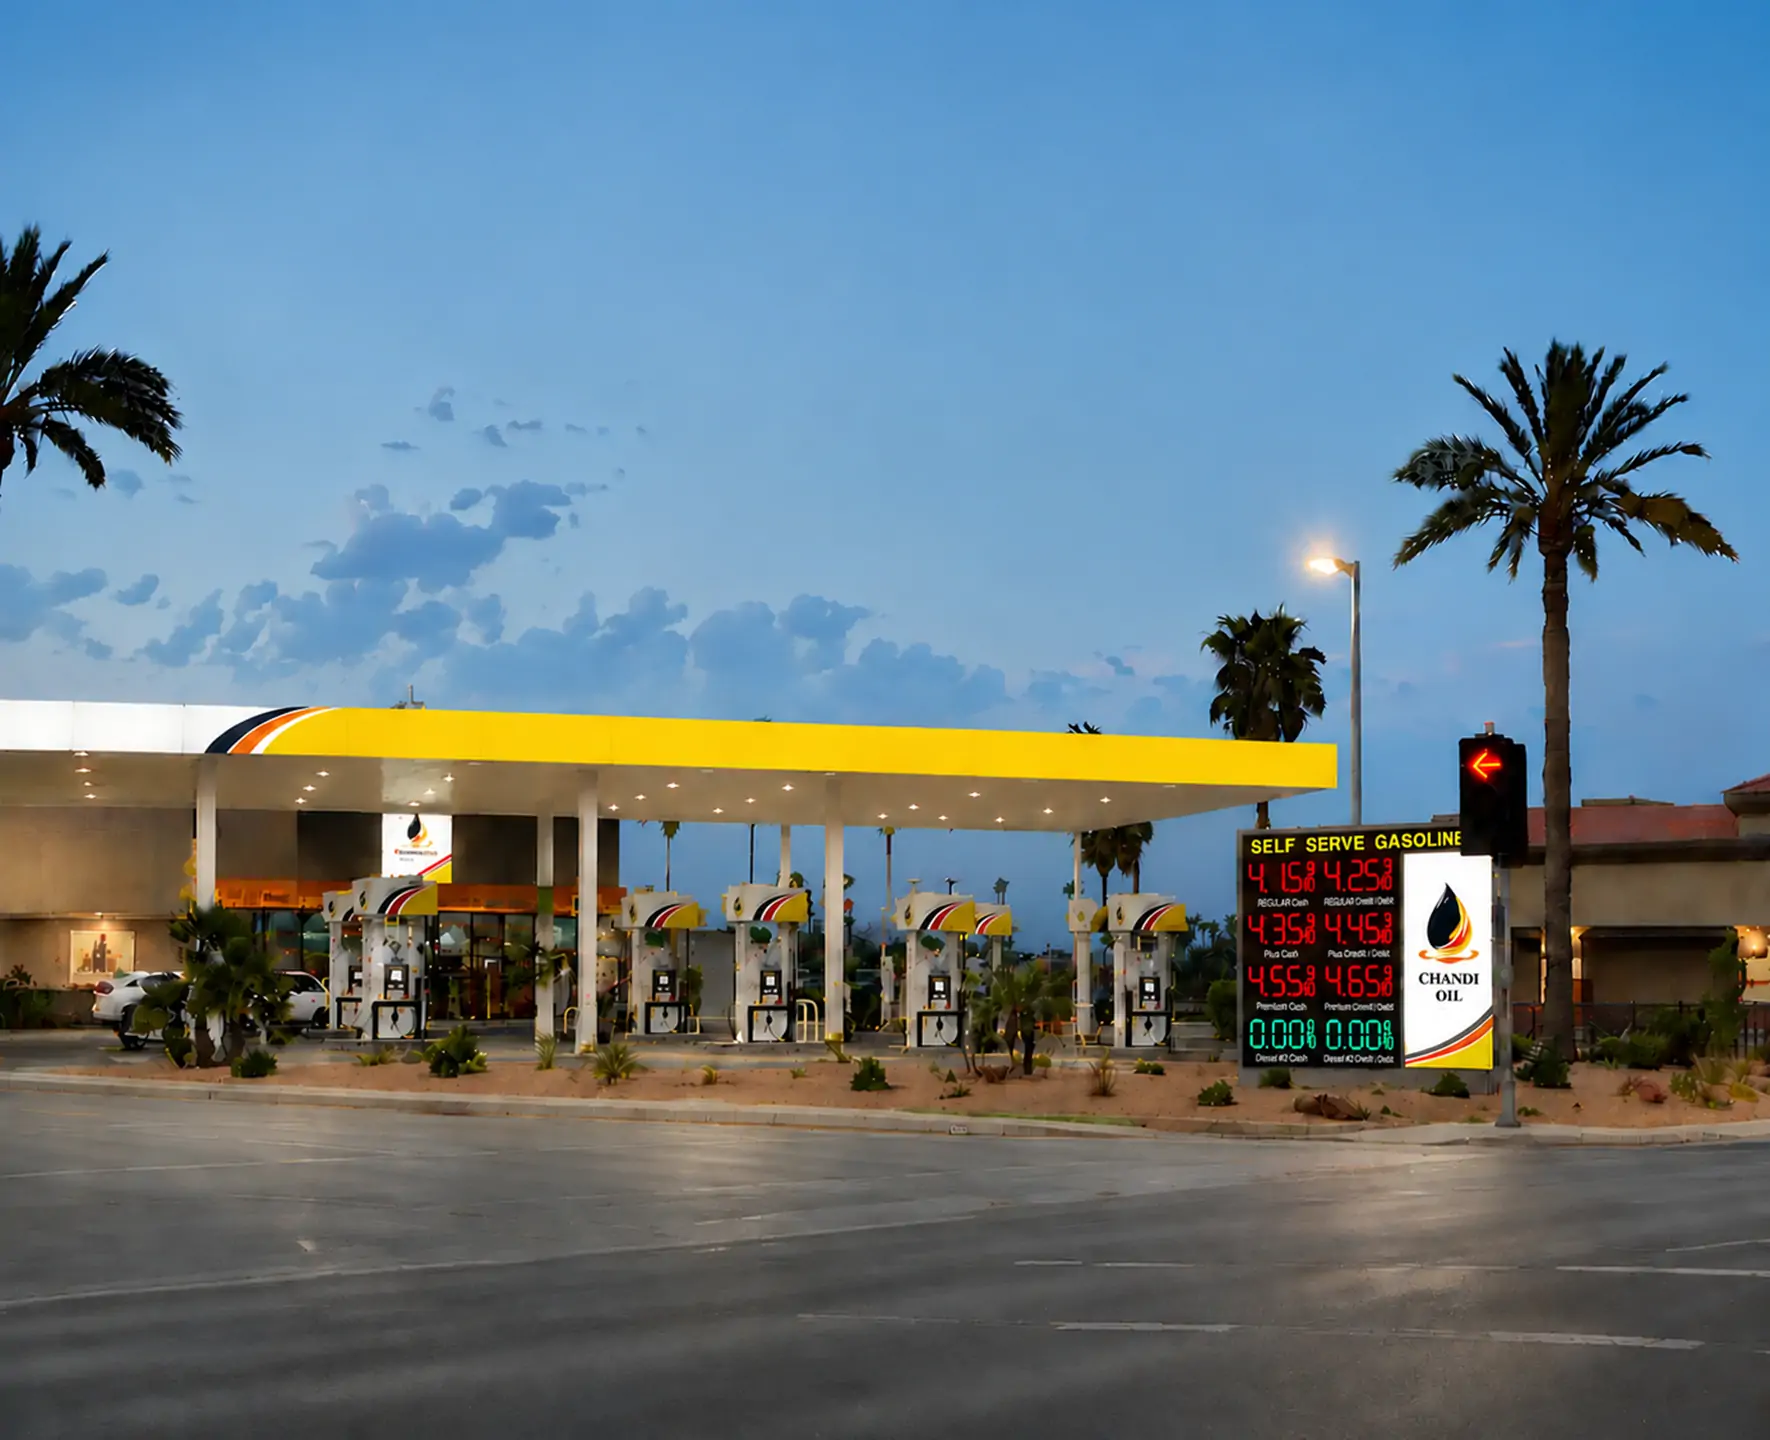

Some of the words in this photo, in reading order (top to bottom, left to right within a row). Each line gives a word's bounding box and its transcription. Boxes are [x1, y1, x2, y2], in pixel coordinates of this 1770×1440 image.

[1251, 838, 1296, 854] SELF
[1306, 835, 1365, 852] SERVE
[1375, 831, 1462, 850] GASOLINE
[1418, 972, 1479, 985] CHANDI
[1436, 989, 1463, 1002] OIL
